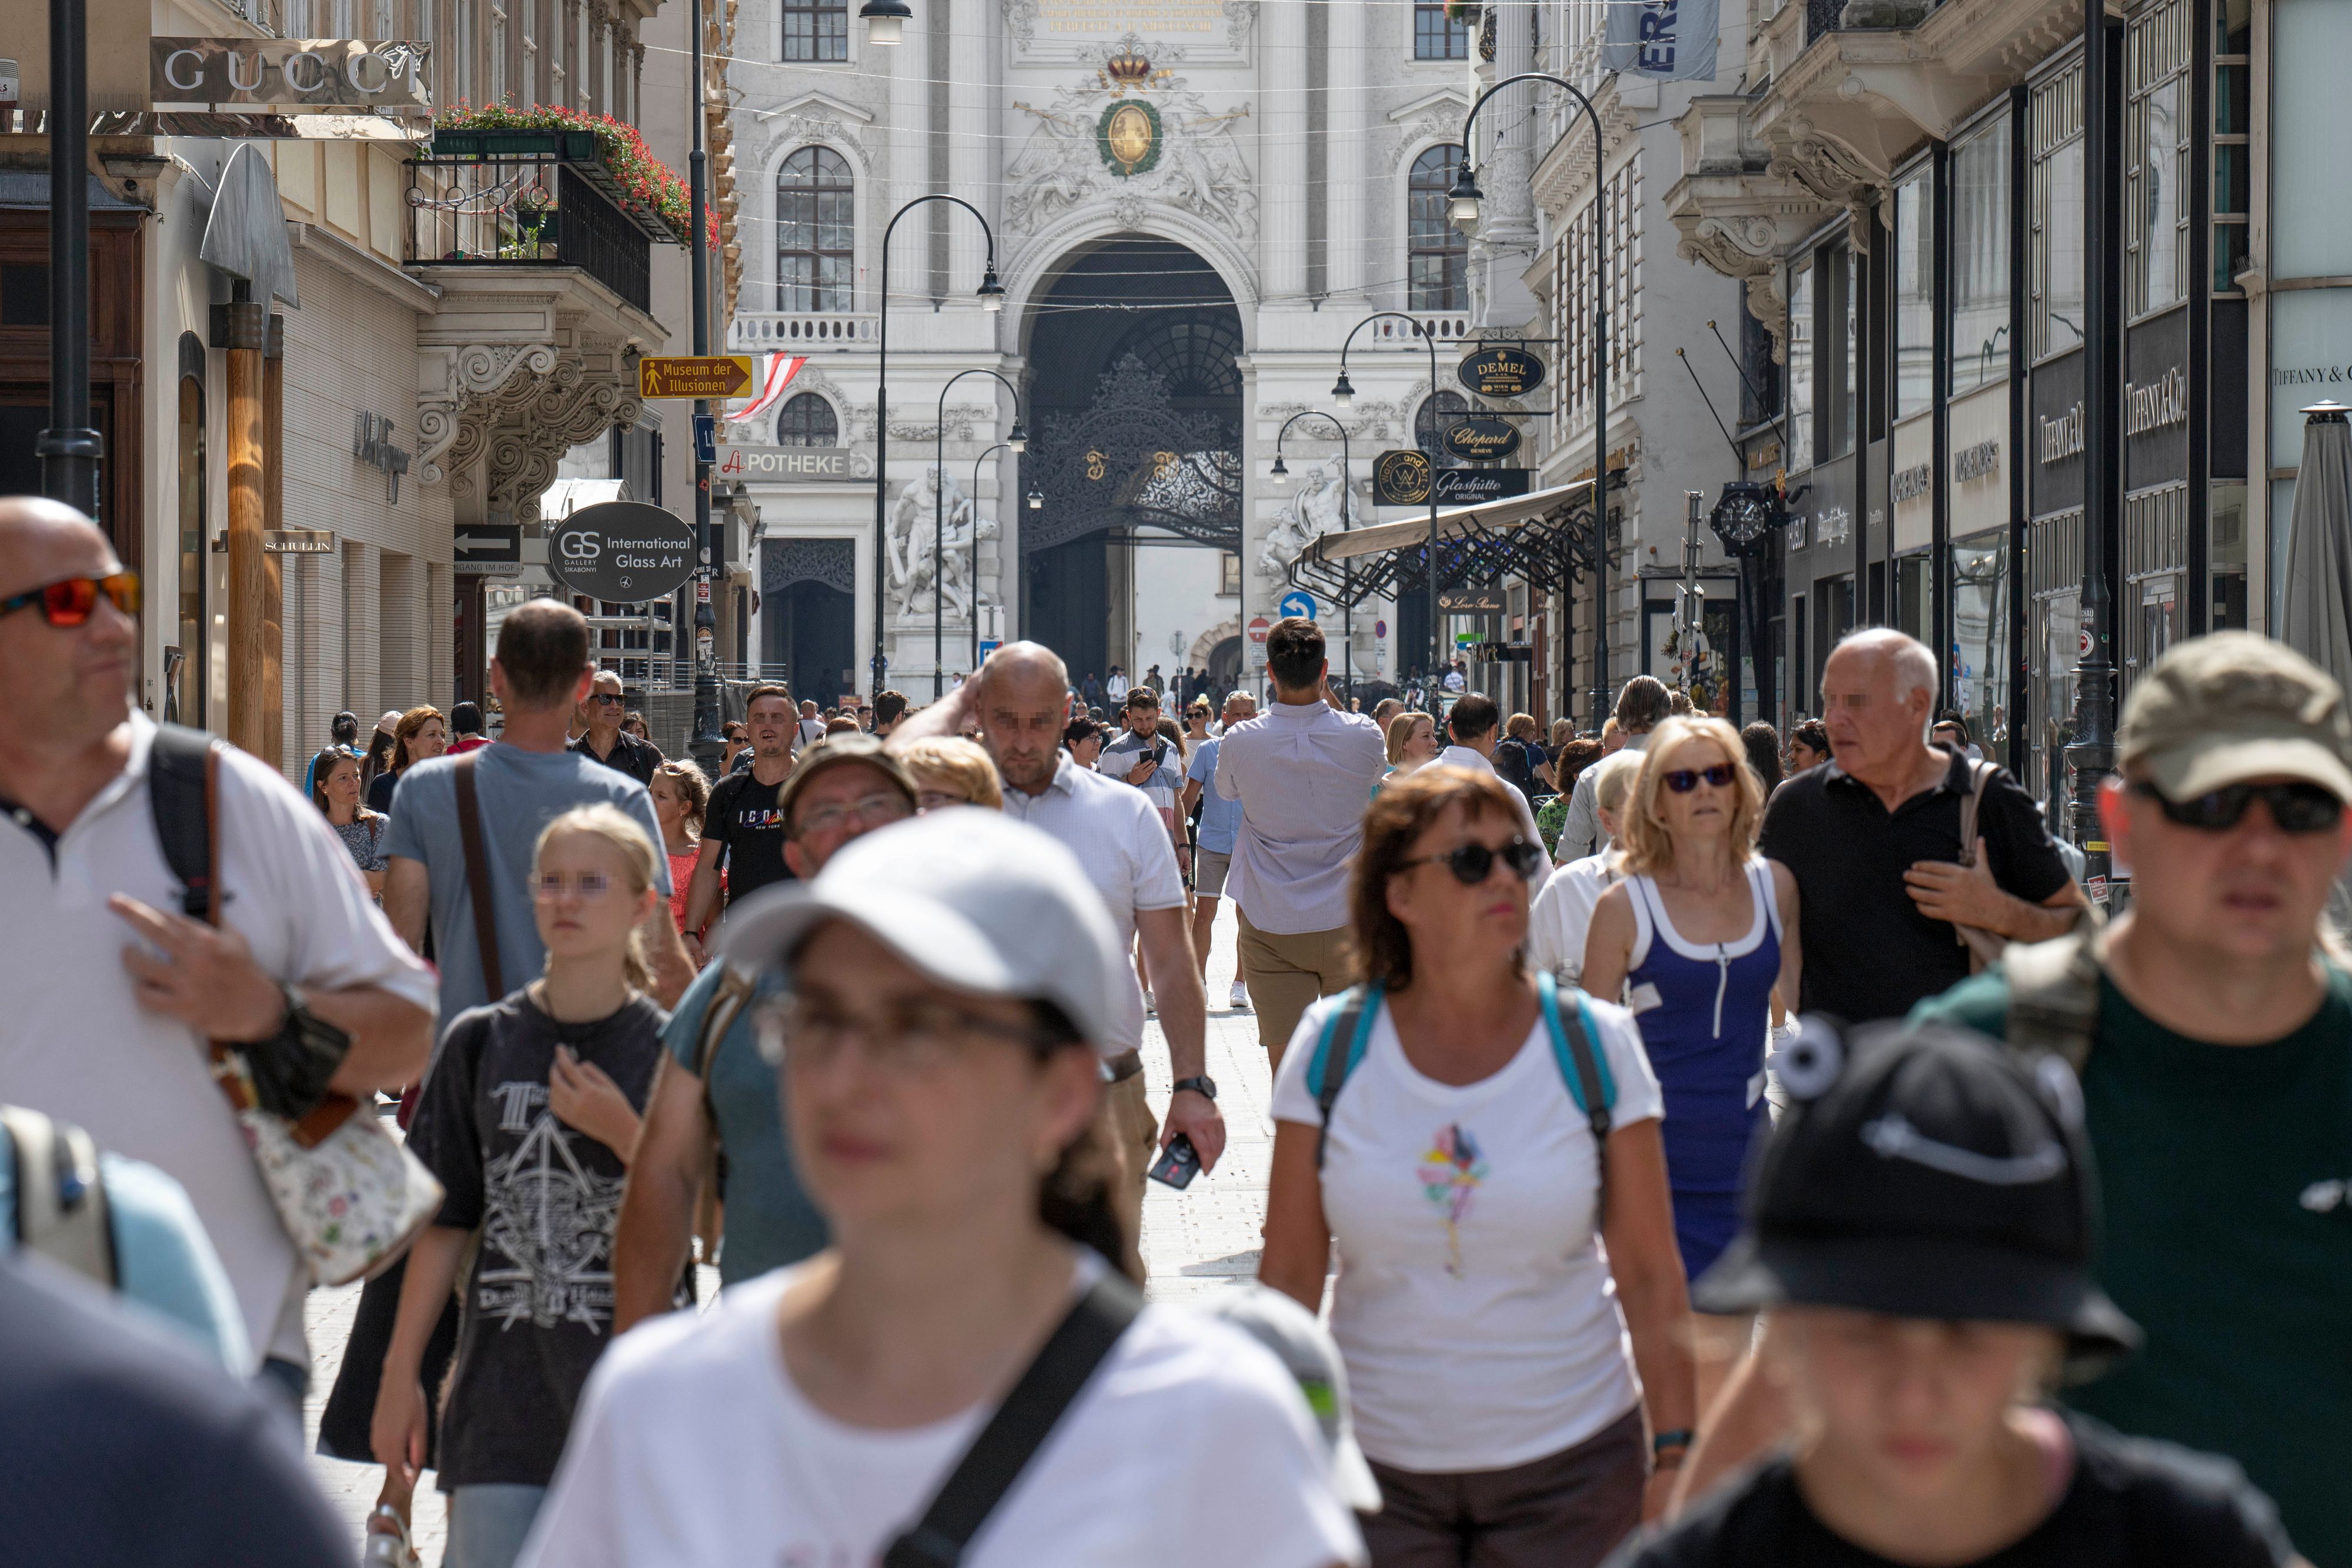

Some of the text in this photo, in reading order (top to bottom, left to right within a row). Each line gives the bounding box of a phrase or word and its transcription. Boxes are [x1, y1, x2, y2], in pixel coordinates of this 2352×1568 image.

[1050, 21, 1109, 32] PERFECIT
[1114, 21, 1122, 32] A
[1127, 21, 1135, 32] D
[1639, 0, 1678, 72] ER
[163, 49, 417, 93] GUCCI
[664, 363, 731, 376] Museum der
[1477, 362, 1527, 376] DEMEL
[2273, 368, 2326, 386] TIFFANY
[2328, 365, 2344, 383] &
[669, 379, 726, 392] Illusionen
[2126, 383, 2160, 436] TIFFANY
[1451, 427, 1513, 448] Chopard
[721, 450, 844, 474] APOTHEKE
[1381, 454, 1429, 484] Watch and Art
[1436, 470, 1501, 497] Glashütte
[265, 542, 330, 551] SCHULLIN
[560, 531, 601, 559] GS
[607, 537, 690, 549] International
[616, 554, 682, 568] Glass Art
[1451, 595, 1502, 609] Loro Piana
